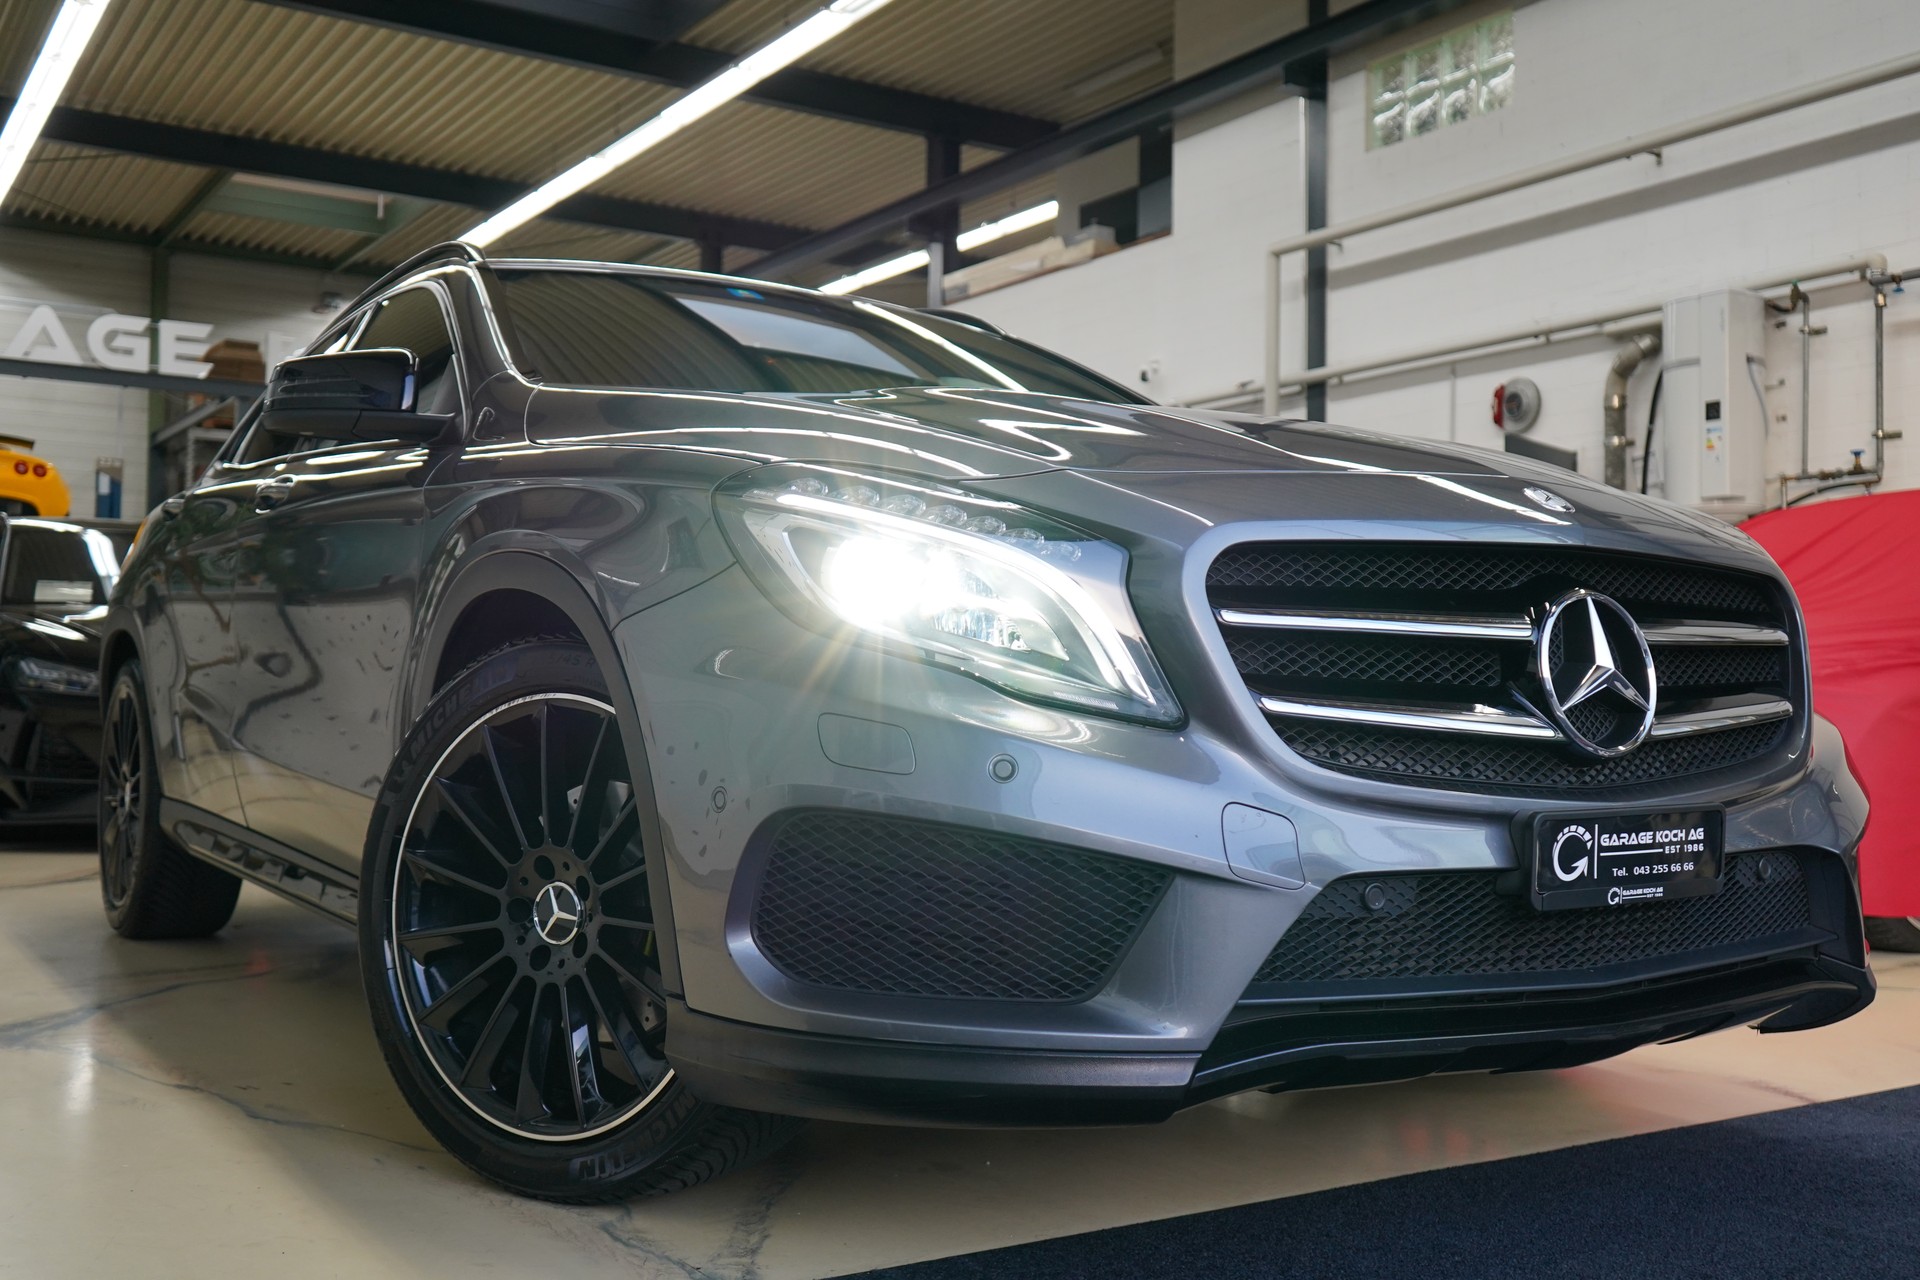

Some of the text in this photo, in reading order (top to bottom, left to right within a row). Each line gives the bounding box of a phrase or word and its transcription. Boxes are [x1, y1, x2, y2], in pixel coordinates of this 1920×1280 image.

[1600, 827, 1705, 847] GARAGE KOCH AG
[1664, 843, 1704, 854] EST 1986
[1612, 862, 1694, 877] Tel. 043 255 66 66
